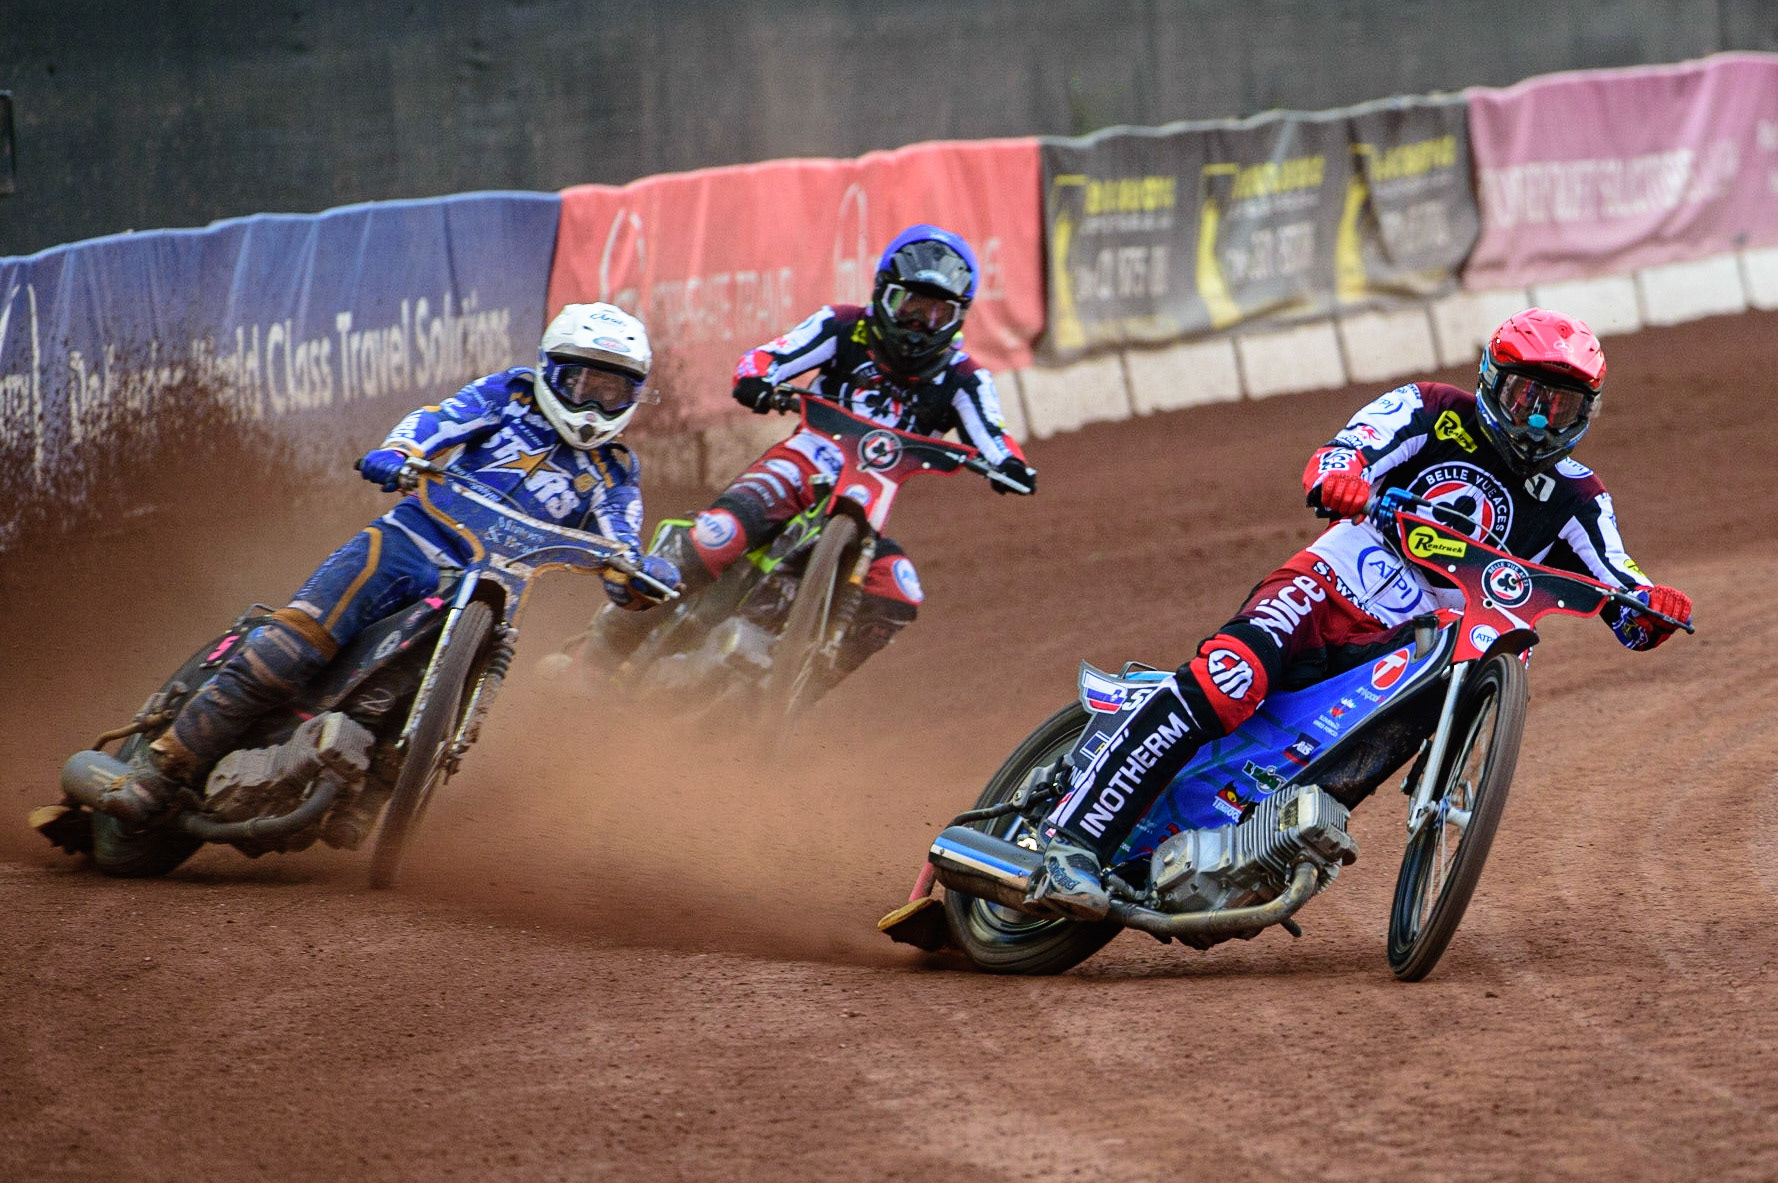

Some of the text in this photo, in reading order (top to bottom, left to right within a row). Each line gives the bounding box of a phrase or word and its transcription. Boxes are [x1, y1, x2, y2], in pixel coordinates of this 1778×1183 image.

[266, 317, 333, 415] Class
[335, 311, 410, 401] Travel
[1425, 467, 1508, 532] BELLE VUE ACES
[1414, 532, 1464, 554] Rentruck
[1487, 561, 1505, 574] BELLE
[1506, 562, 1520, 572] VUE
[1475, 632, 1495, 643] ATP
[1079, 711, 1190, 839] INOTHERM
